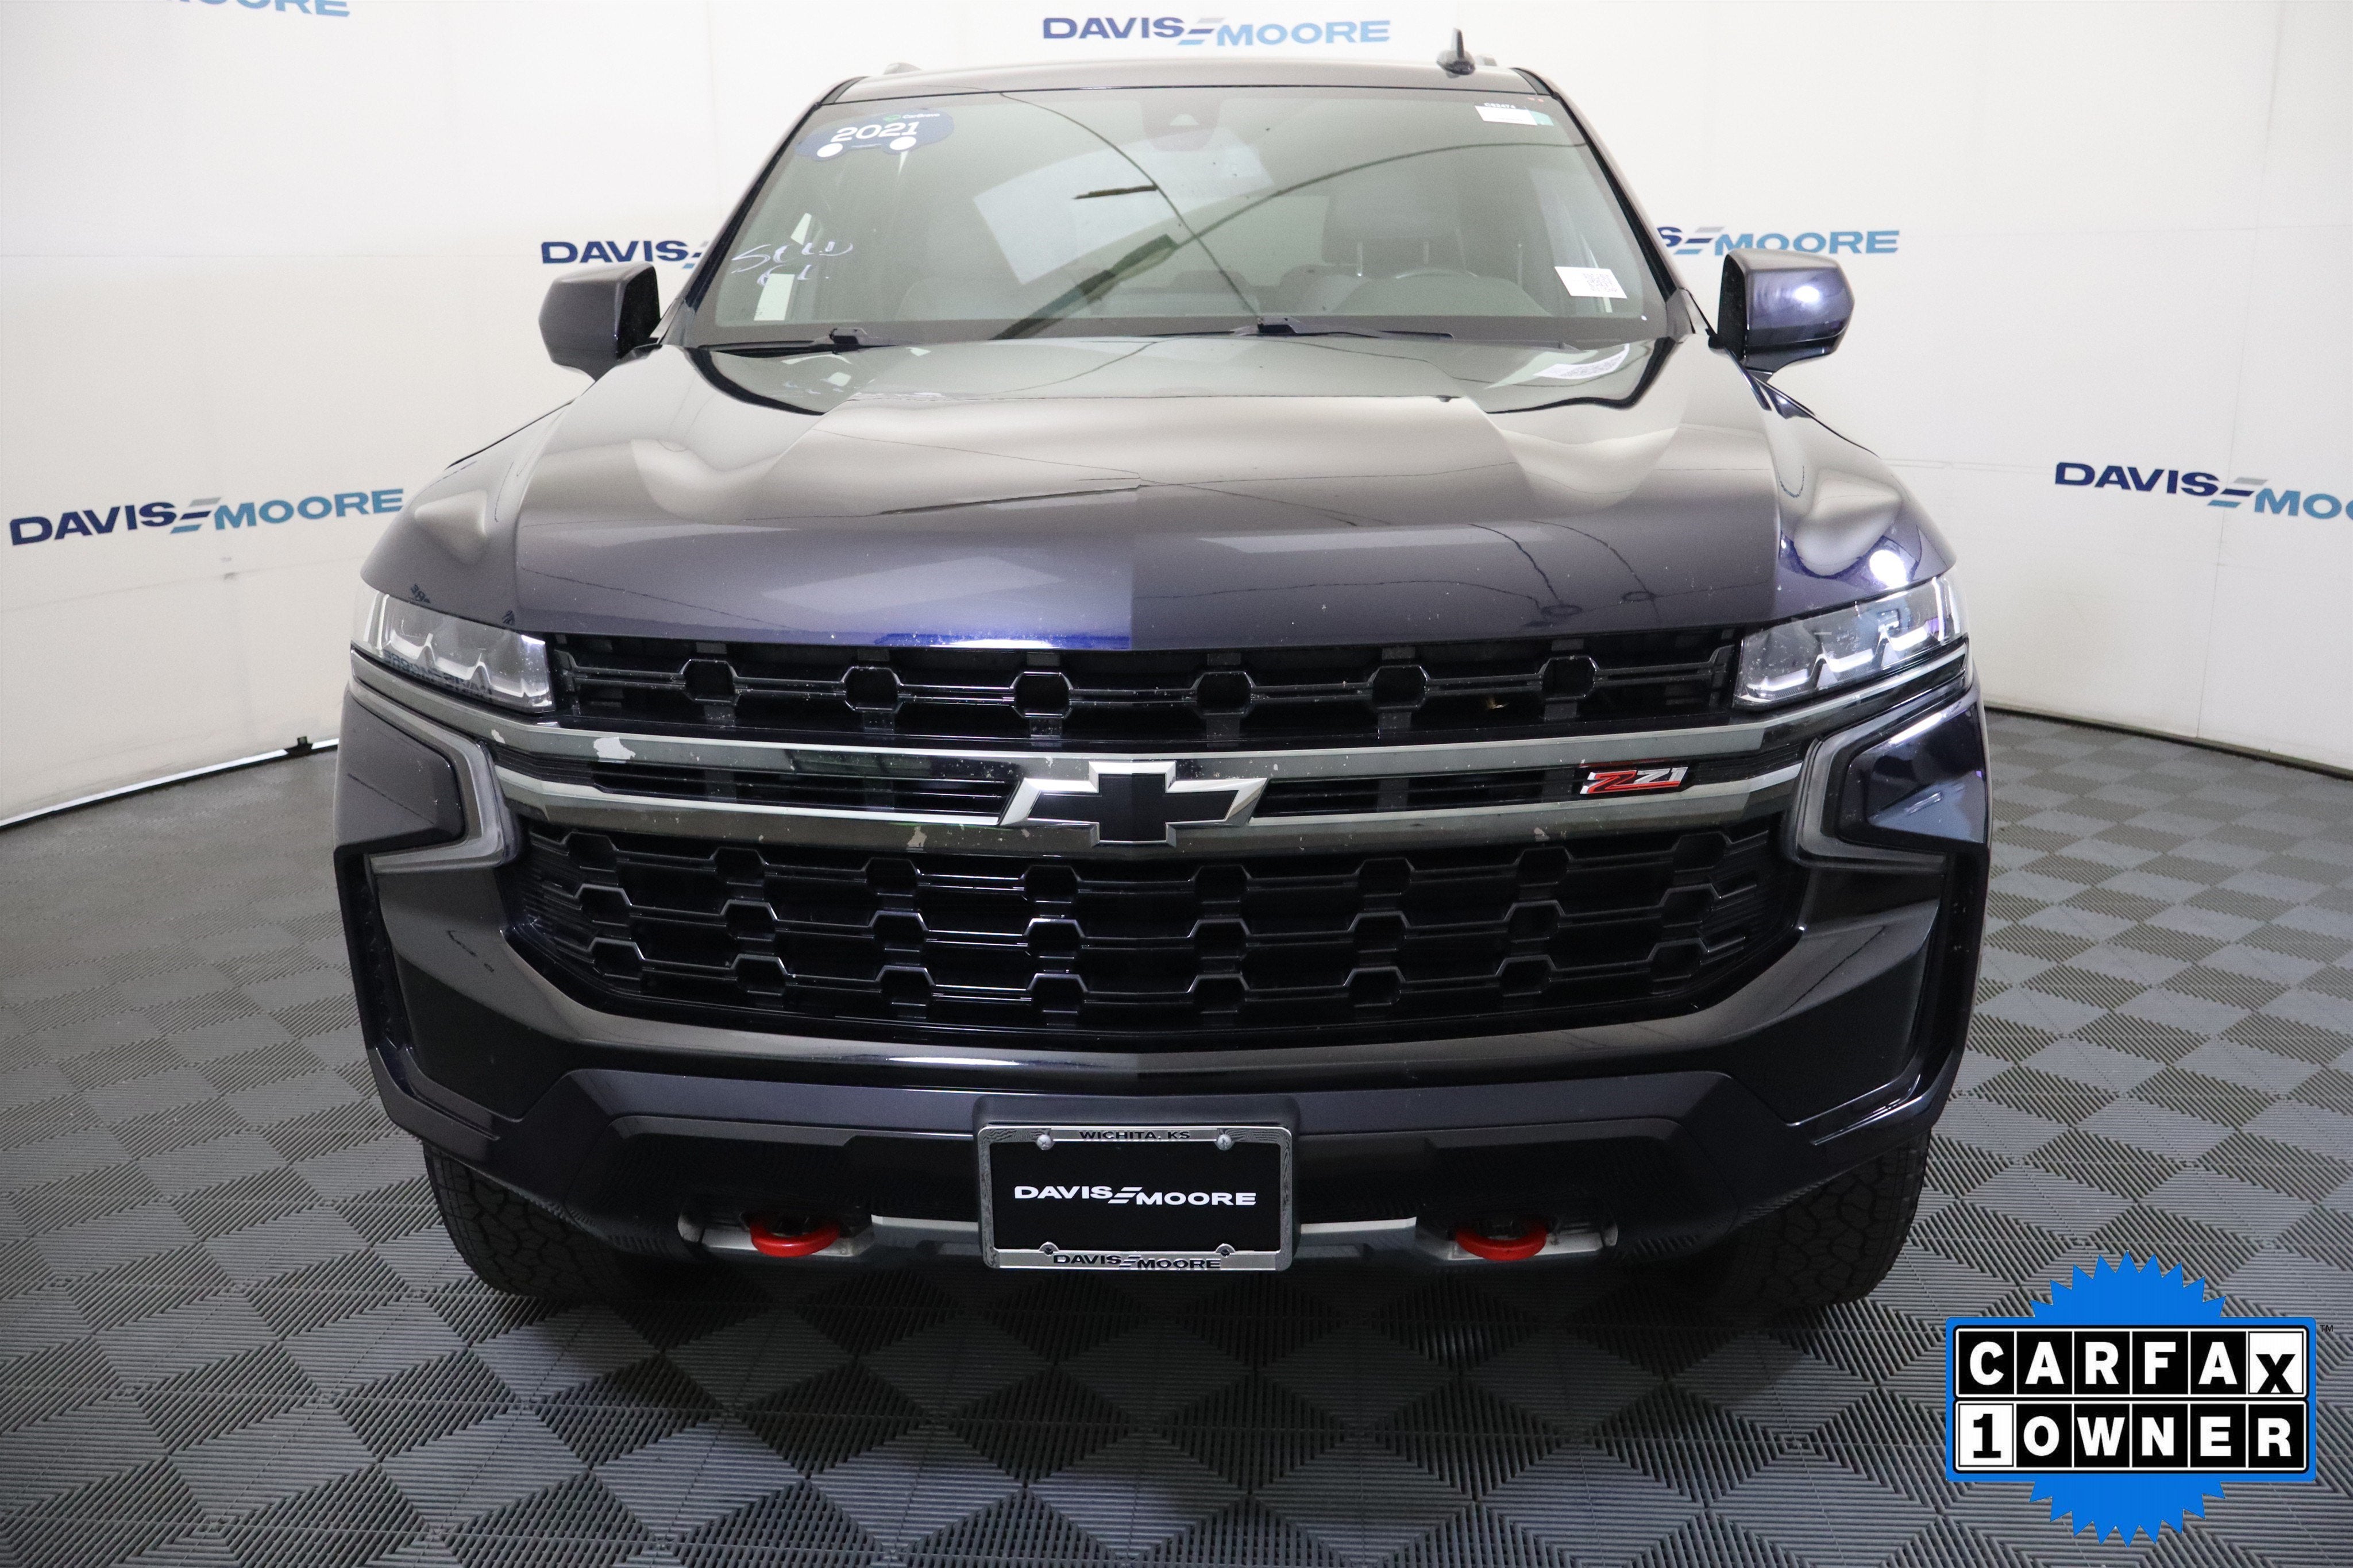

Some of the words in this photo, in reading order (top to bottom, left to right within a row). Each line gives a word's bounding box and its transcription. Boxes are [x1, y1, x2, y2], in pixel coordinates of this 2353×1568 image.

[1043, 17, 1185, 39] DAVIS
[1216, 20, 1390, 46] MOORE
[831, 121, 919, 142] 2021
[541, 240, 689, 264] DAVIS
[1715, 230, 1900, 256] MOORE
[2055, 462, 2219, 497] DAVIS
[2254, 488, 2353, 522] MO
[9, 502, 178, 546] DAVIS
[214, 488, 403, 530] MOORE
[1580, 767, 1688, 794] Z71
[1167, 1130, 1191, 1140] KS
[1015, 1185, 1113, 1199] DAVIS
[1136, 1192, 1256, 1206] MOORE
[1053, 1254, 1122, 1264] DAVIS
[1137, 1258, 1221, 1269] MOORE
